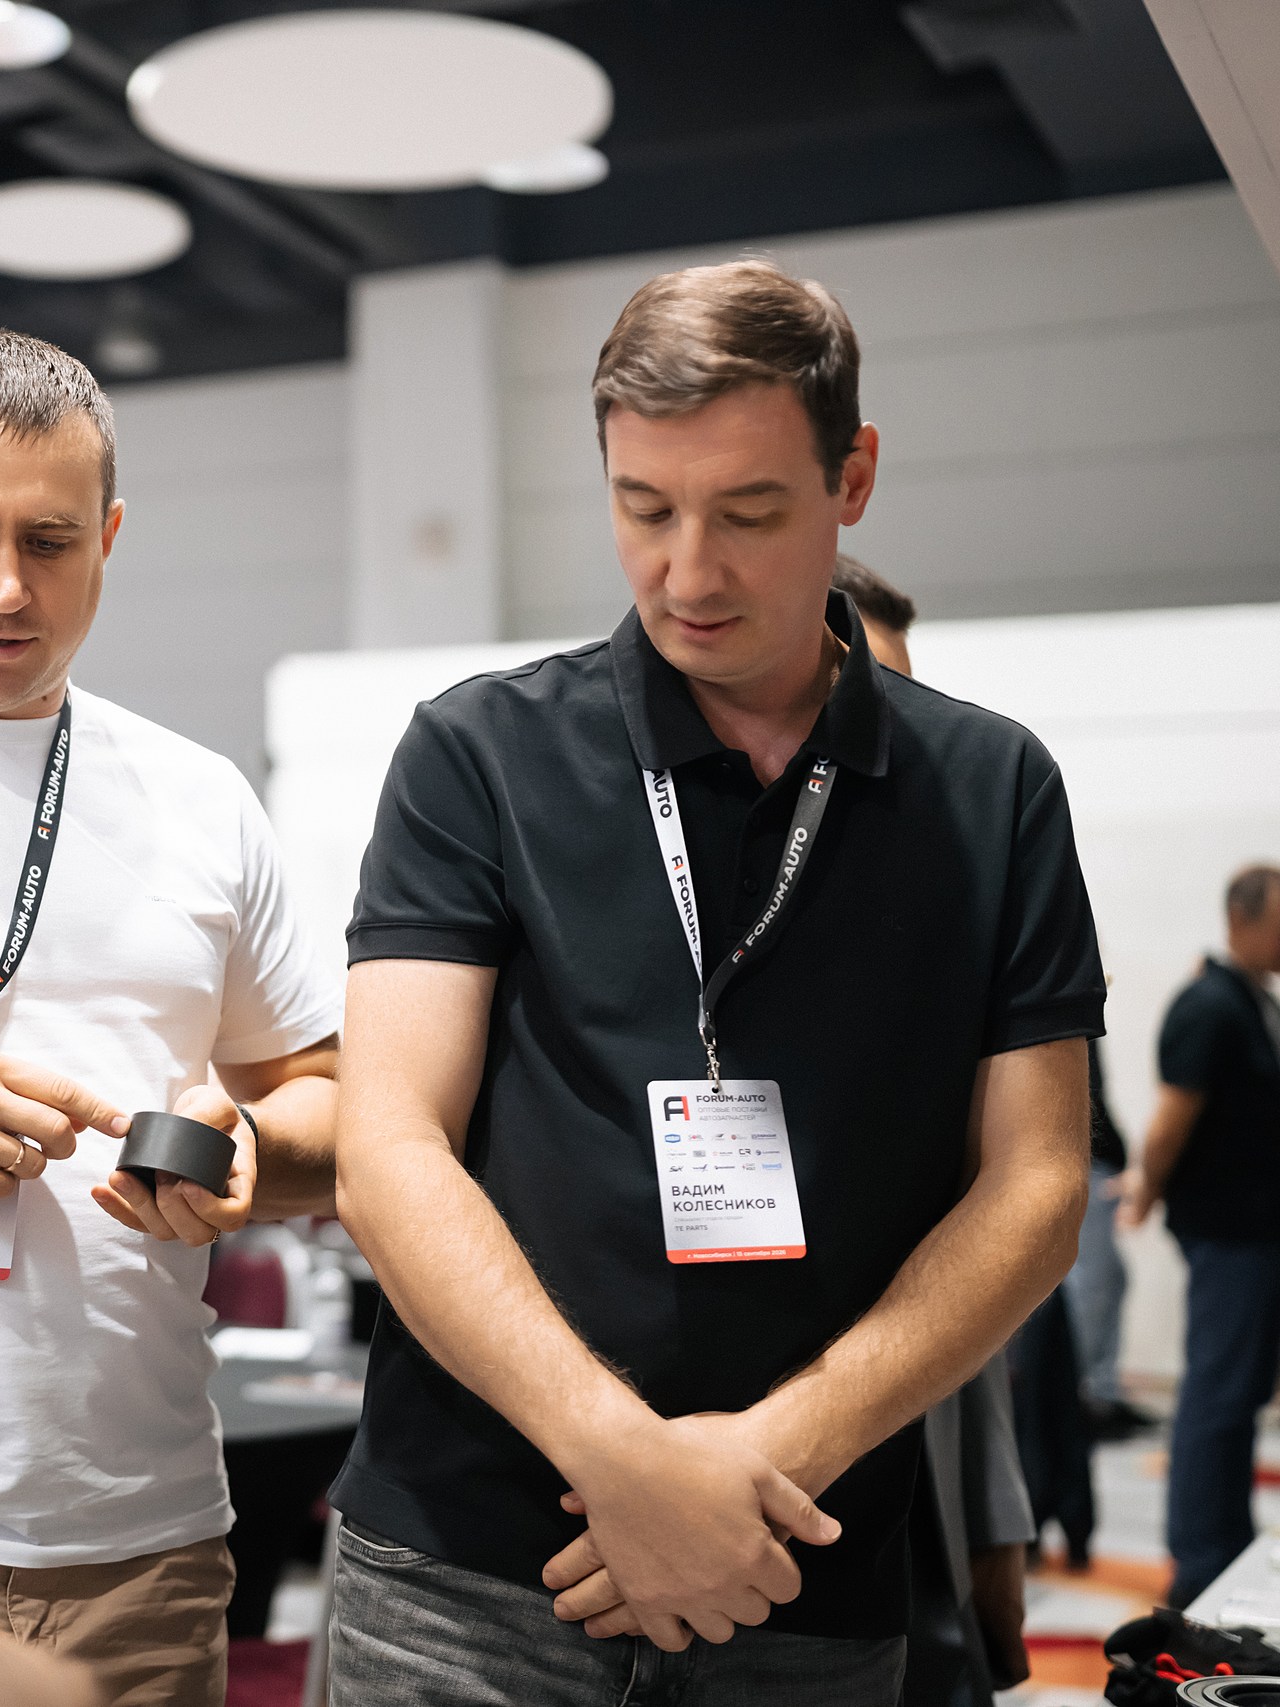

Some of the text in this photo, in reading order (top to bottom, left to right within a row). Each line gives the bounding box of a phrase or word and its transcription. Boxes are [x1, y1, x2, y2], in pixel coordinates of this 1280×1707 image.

[40, 728, 69, 826] FORUM-AUTO
[744, 827, 808, 947] FORUM-AUTO
[2, 865, 42, 974] FORUM-AUTO
[696, 1094, 766, 1103] FORUM-AUTO
[671, 1184, 725, 1197] ВАДИМ
[673, 1198, 776, 1212] КОЛЕСНИКОВ
